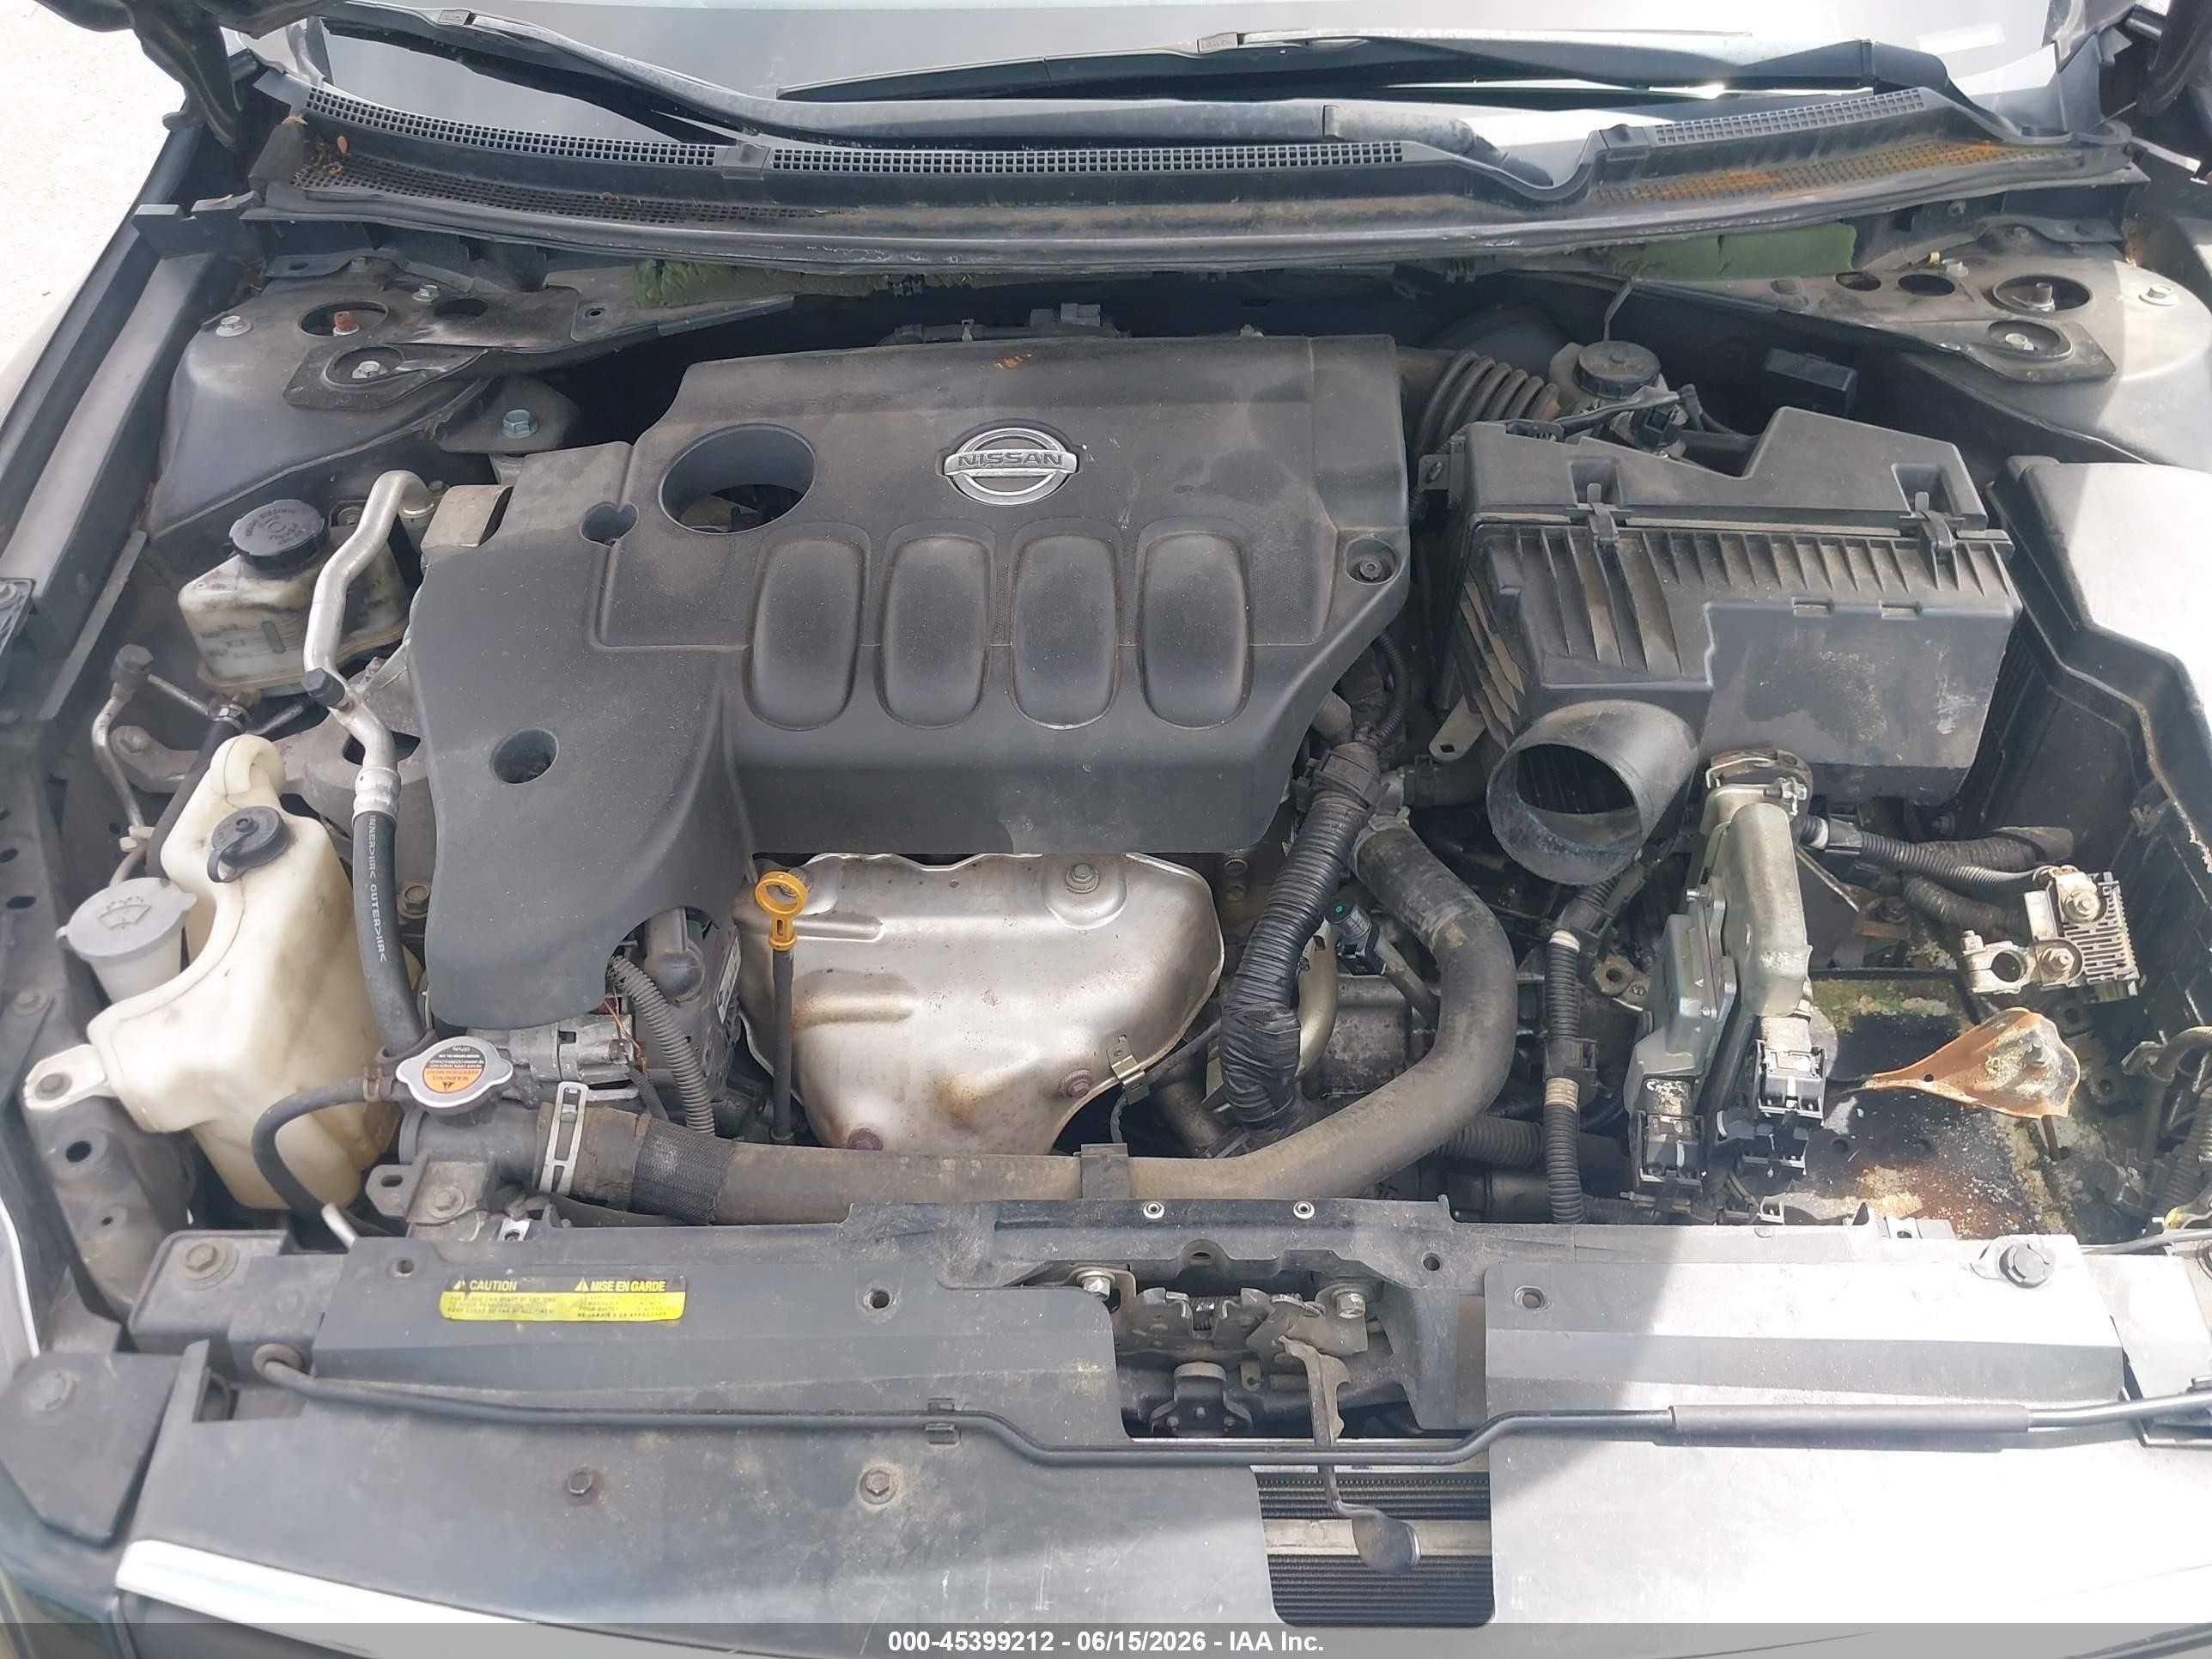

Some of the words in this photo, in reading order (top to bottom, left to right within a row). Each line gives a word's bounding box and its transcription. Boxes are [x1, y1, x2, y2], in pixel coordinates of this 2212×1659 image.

[957, 452, 1062, 467] NISSAN
[470, 1279, 518, 1291] CAUTION
[590, 1280, 614, 1291] MISE
[615, 1280, 630, 1291] EN
[631, 1280, 666, 1291] GARDE
